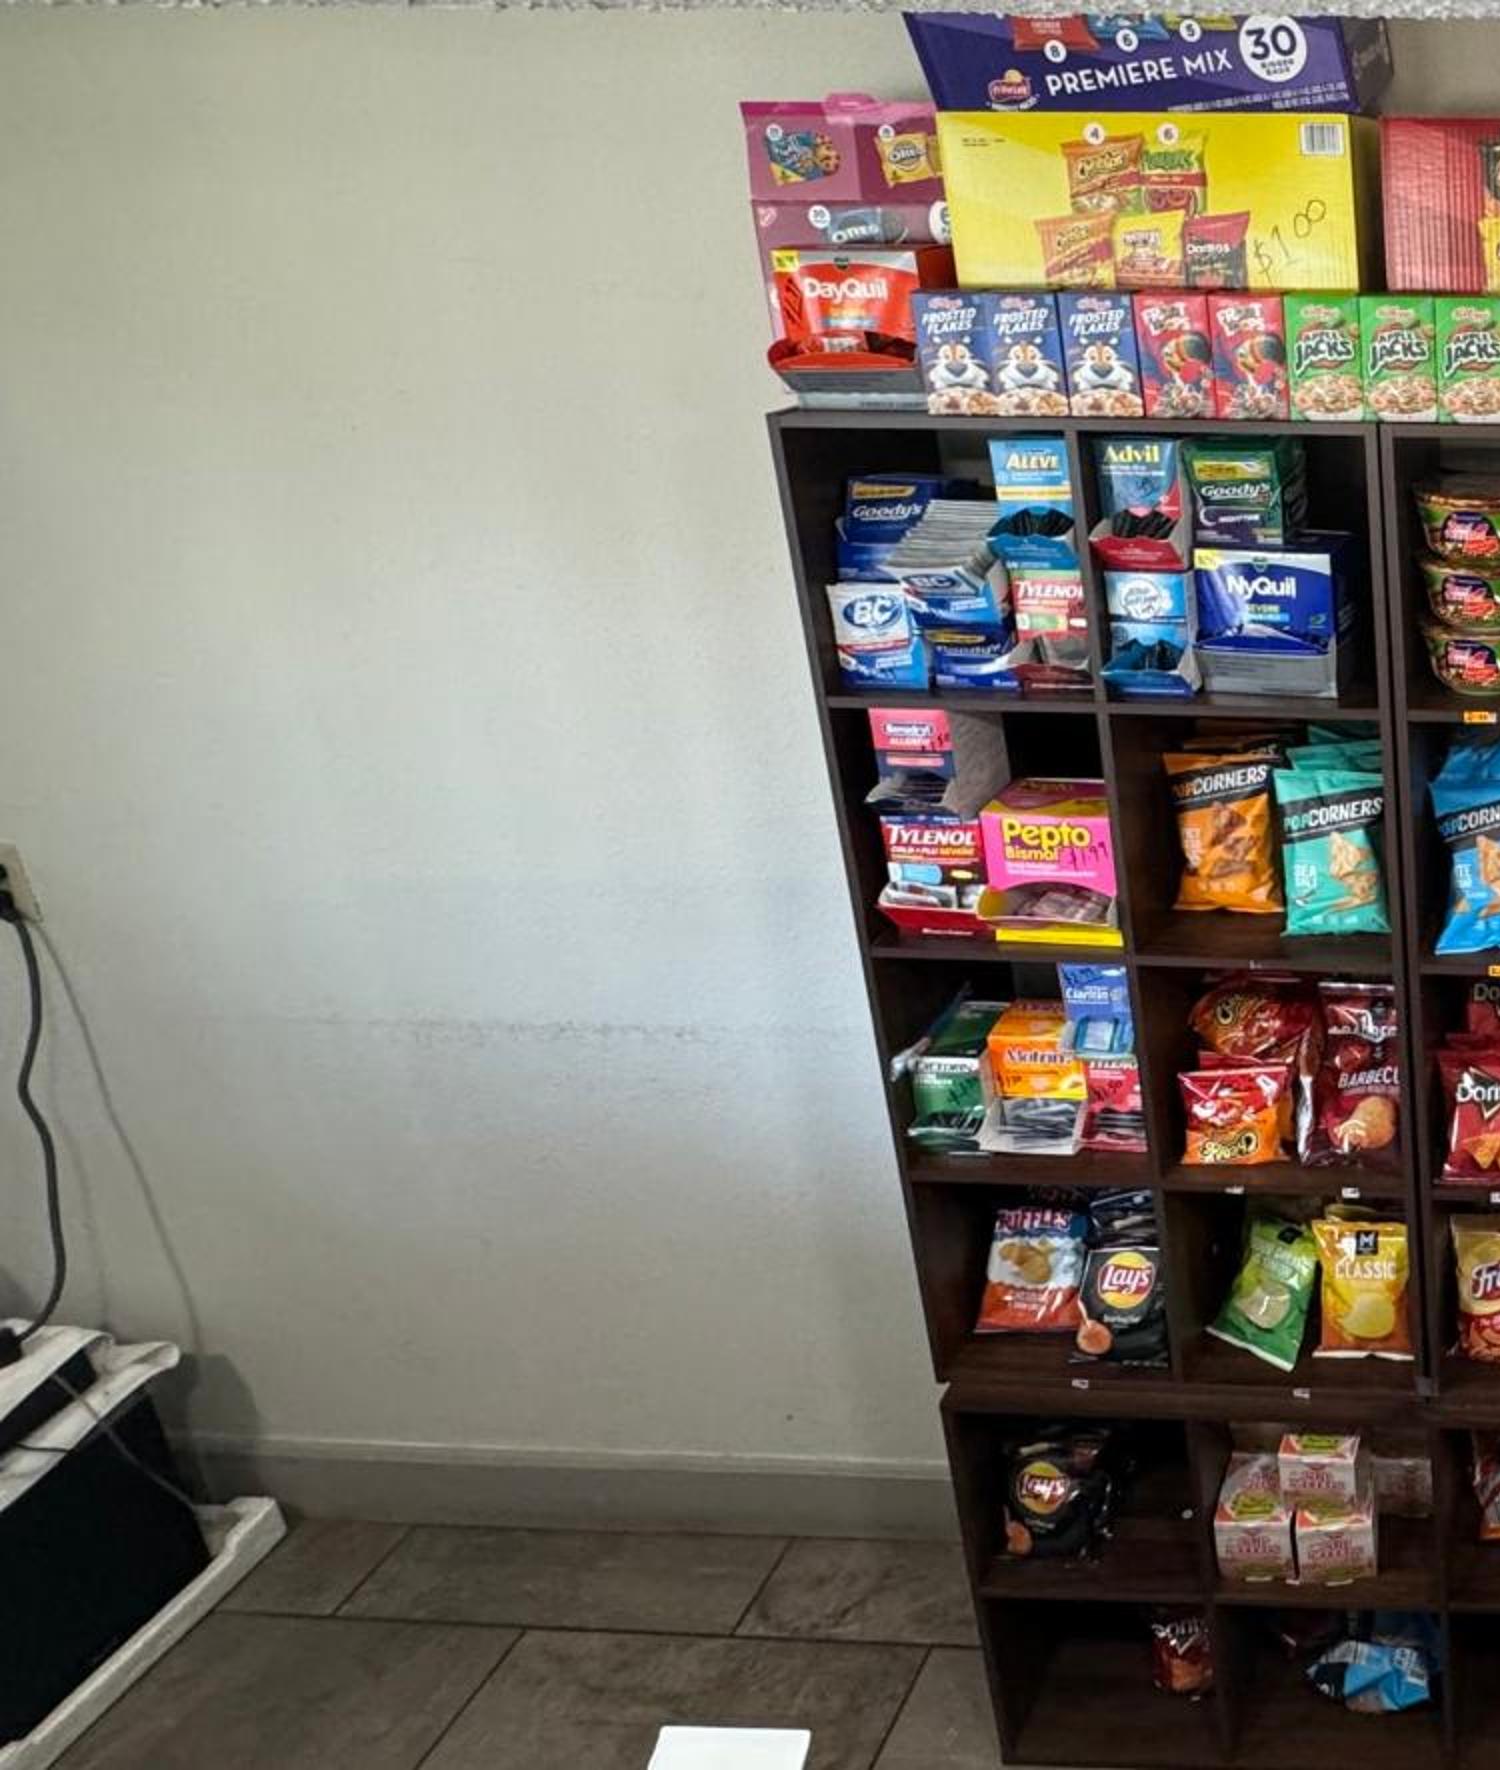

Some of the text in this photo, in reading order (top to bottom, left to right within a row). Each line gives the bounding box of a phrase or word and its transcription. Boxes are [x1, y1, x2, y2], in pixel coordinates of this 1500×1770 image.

[1121, 33, 1133, 47] 6
[1245, 24, 1297, 61] 30
[1050, 46, 1061, 59] 8
[1044, 57, 1177, 97] PREMIERE
[1182, 49, 1233, 76] MIX
[1163, 129, 1173, 139] 6
[804, 277, 888, 303] DayQuil
[1296, 339, 1354, 375] JACKS
[1370, 339, 1428, 376] JACKS
[1103, 445, 1160, 464] Advil
[1201, 482, 1271, 499] Goody's
[853, 502, 923, 521] Goody's
[1227, 576, 1297, 600] NyQuil
[853, 594, 898, 626] BC
[889, 825, 976, 847] TYLENOL
[1002, 818, 1090, 852] Pepto
[1005, 845, 1059, 864] Bismol
[1103, 1264, 1151, 1294] Lay's
[1335, 1261, 1397, 1280] CLASSIC
